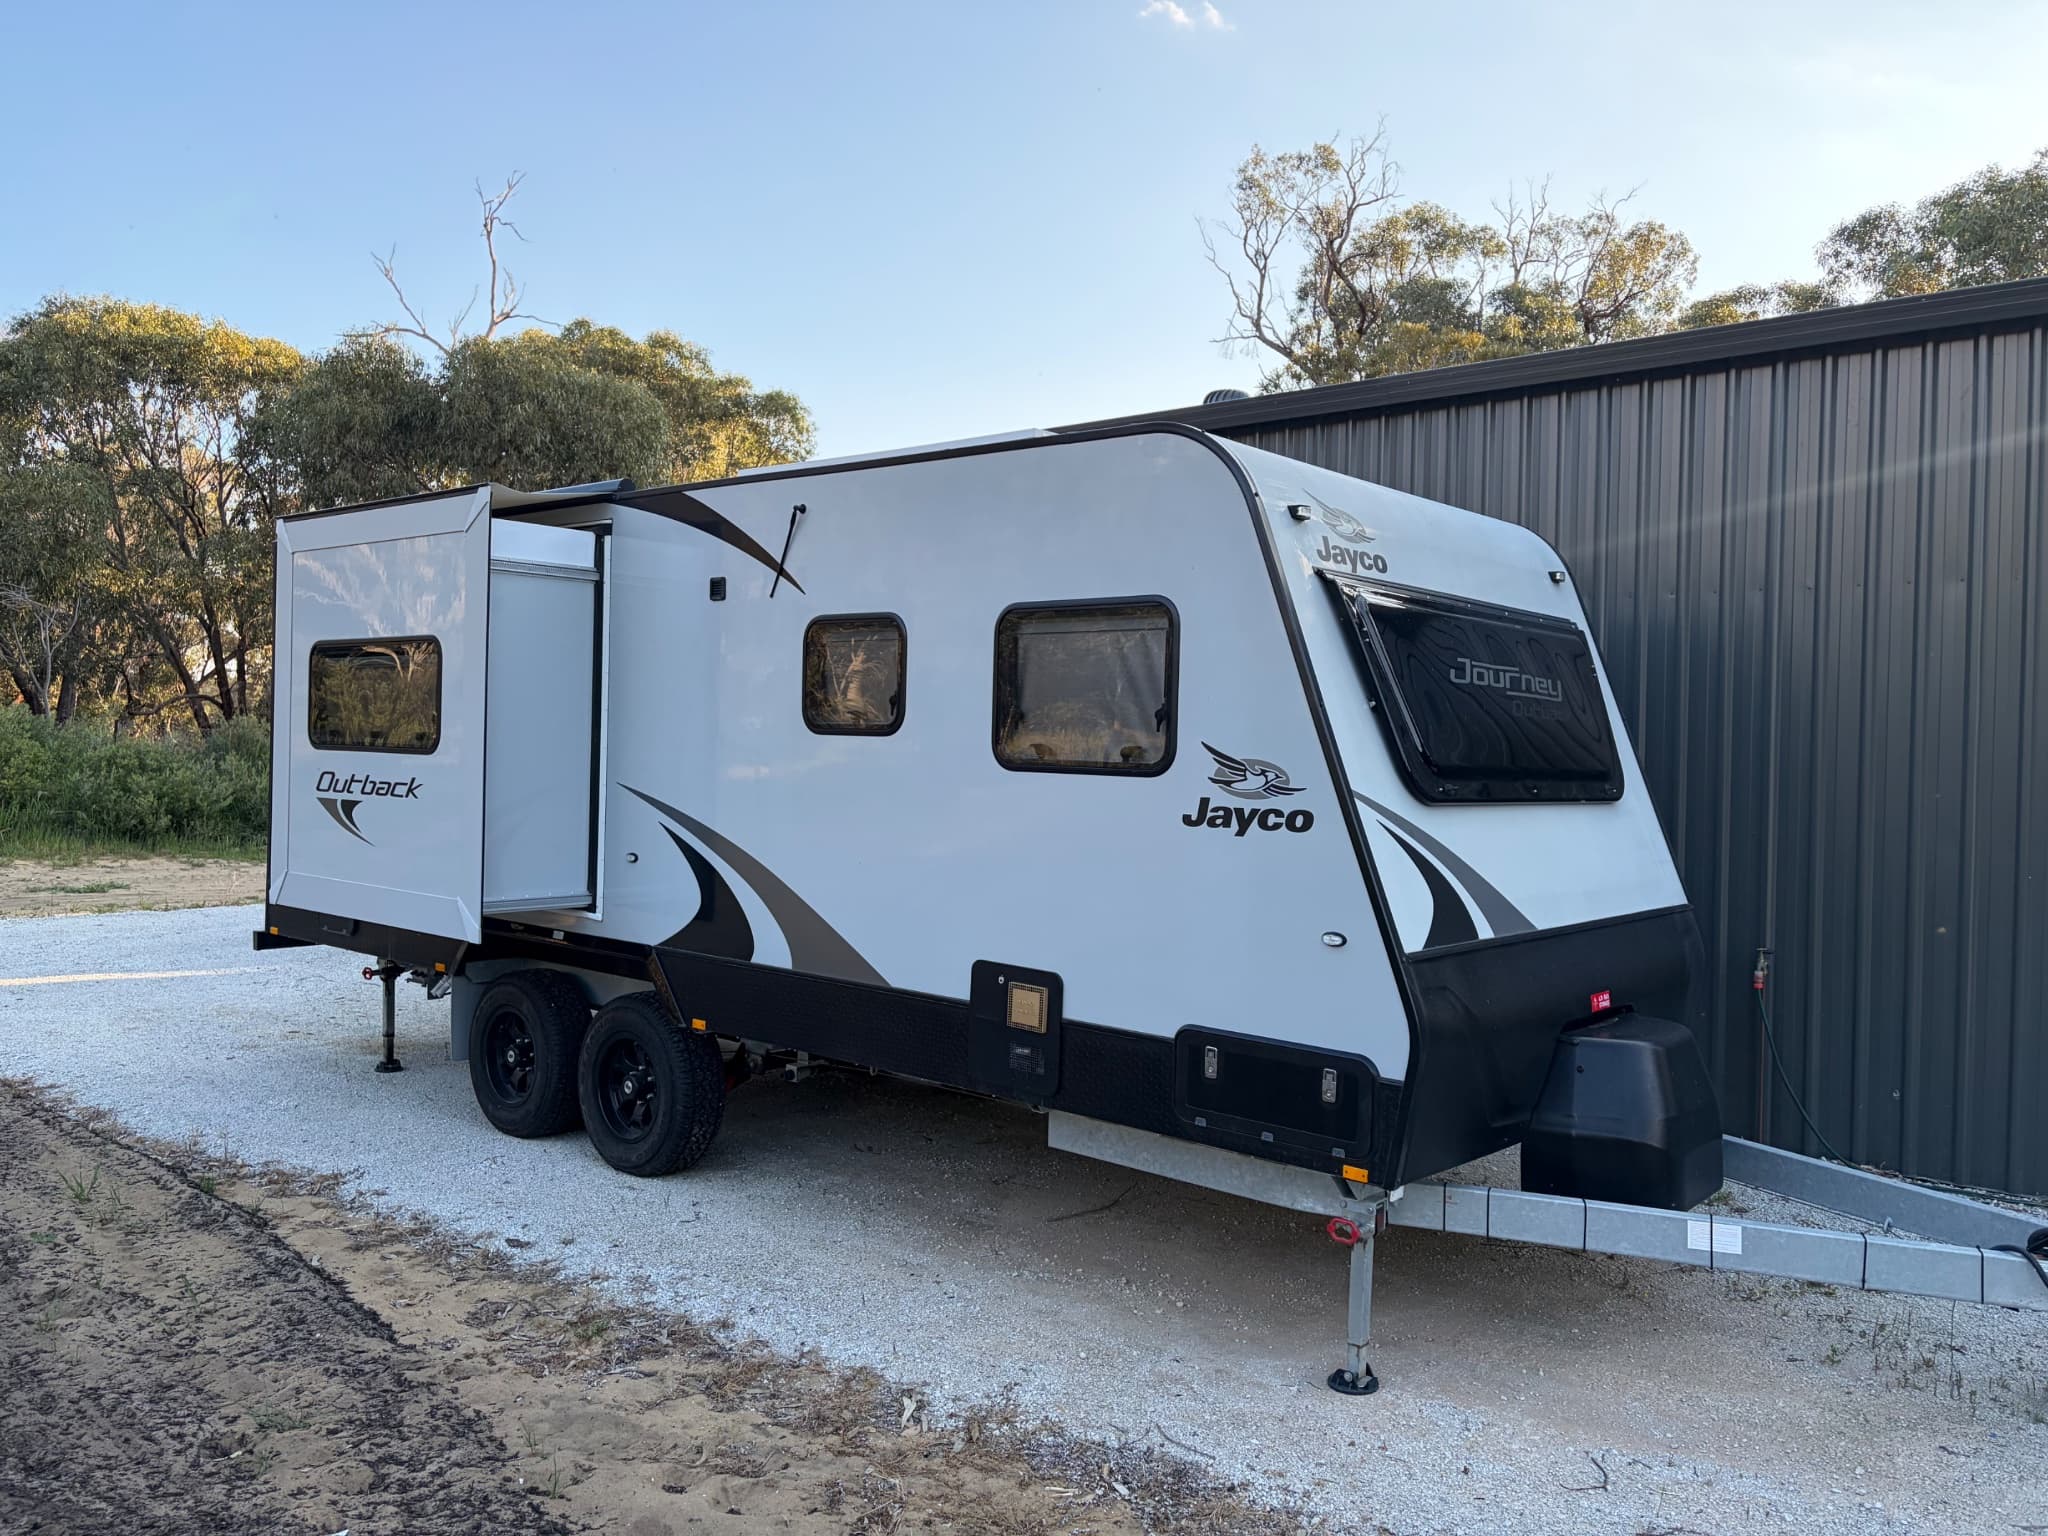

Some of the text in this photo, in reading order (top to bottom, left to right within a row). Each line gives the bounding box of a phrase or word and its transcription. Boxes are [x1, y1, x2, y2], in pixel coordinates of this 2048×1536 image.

[1316, 535, 1388, 574] Jayco
[1449, 657, 1562, 702] Journey
[316, 771, 423, 799] Outback
[1182, 797, 1314, 837] Jayco
